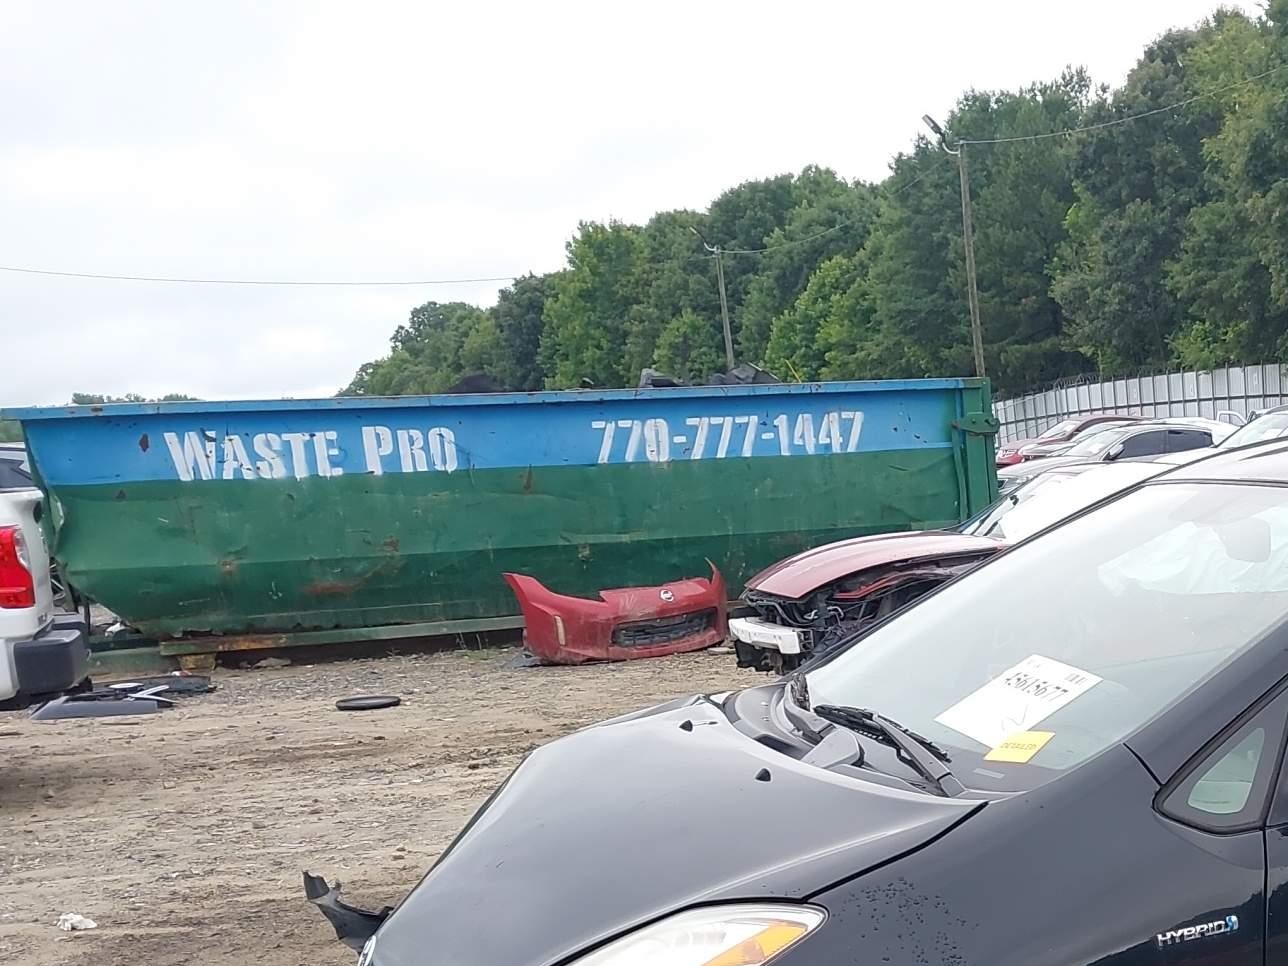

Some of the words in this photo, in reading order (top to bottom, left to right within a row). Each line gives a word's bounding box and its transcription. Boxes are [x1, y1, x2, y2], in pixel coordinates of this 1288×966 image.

[163, 430, 344, 481] WASTE
[361, 425, 458, 475] PRO
[591, 411, 864, 464] 770-777-1447
[1004, 672, 1069, 702] 45615677
[1157, 920, 1229, 947] HYBRID
